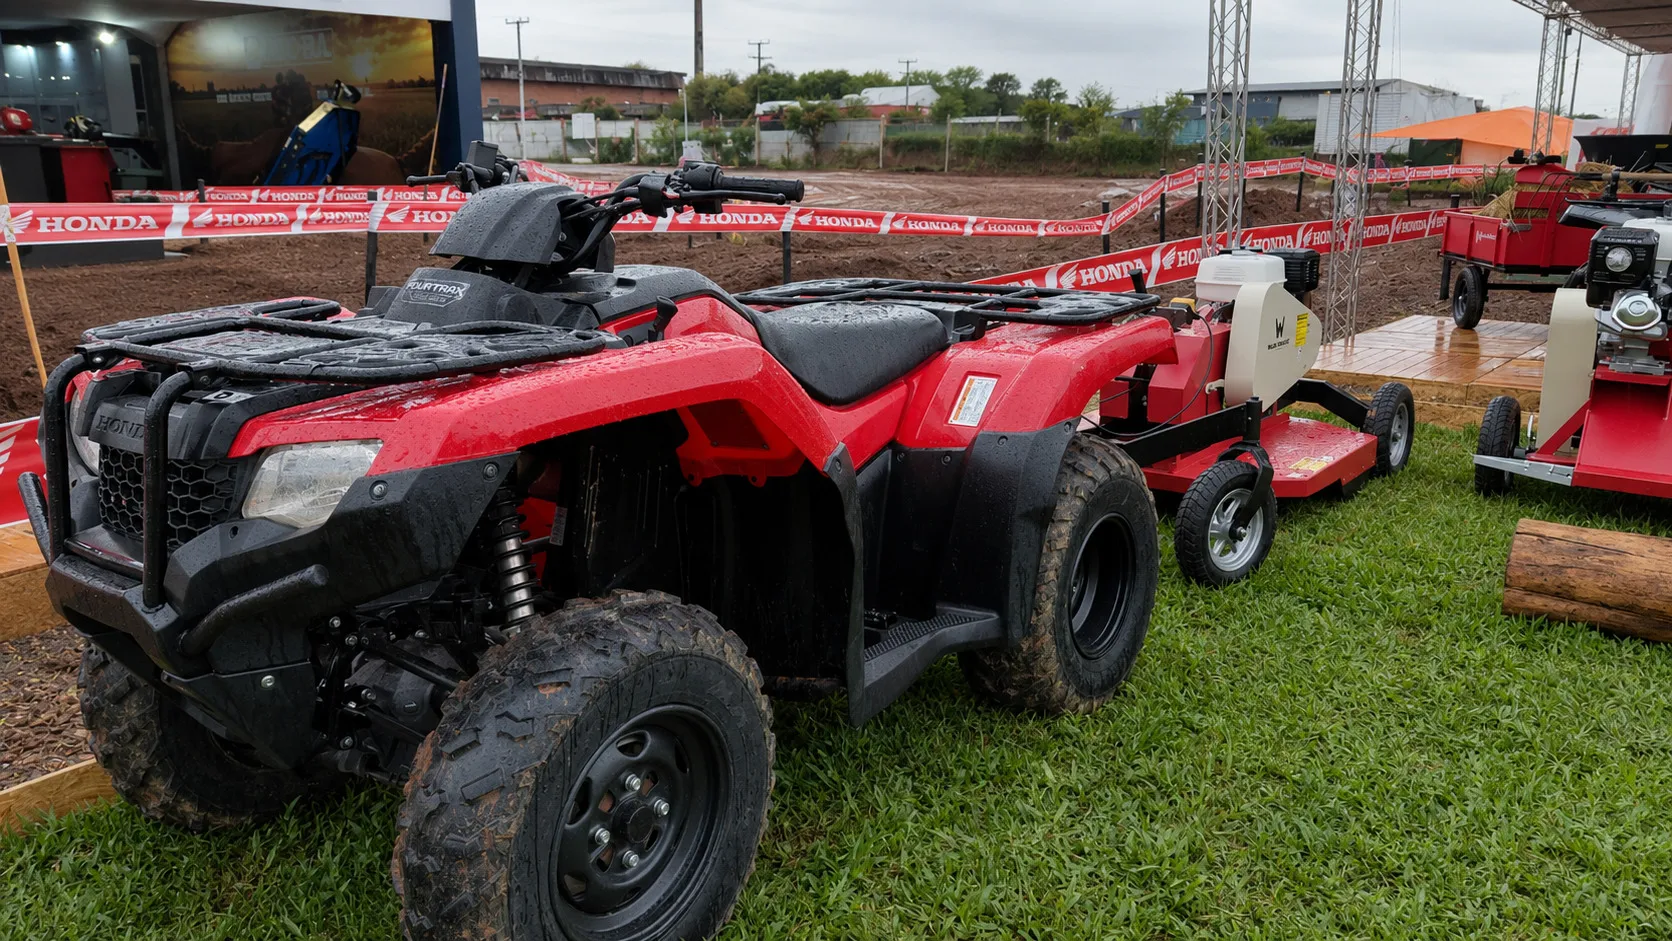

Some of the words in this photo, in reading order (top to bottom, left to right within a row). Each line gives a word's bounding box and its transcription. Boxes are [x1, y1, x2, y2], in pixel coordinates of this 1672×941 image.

[36, 215, 159, 233] HONDA
[215, 212, 289, 227] HONDA
[699, 213, 778, 224] HONDA
[815, 216, 879, 228] HONDA
[906, 220, 962, 231] HONDA
[988, 223, 1036, 233] HONDA
[1252, 234, 1293, 253] HONDA
[1079, 257, 1149, 286] HONDA
[405, 280, 463, 297] FOURTRAX
[96, 414, 145, 439] HOND
